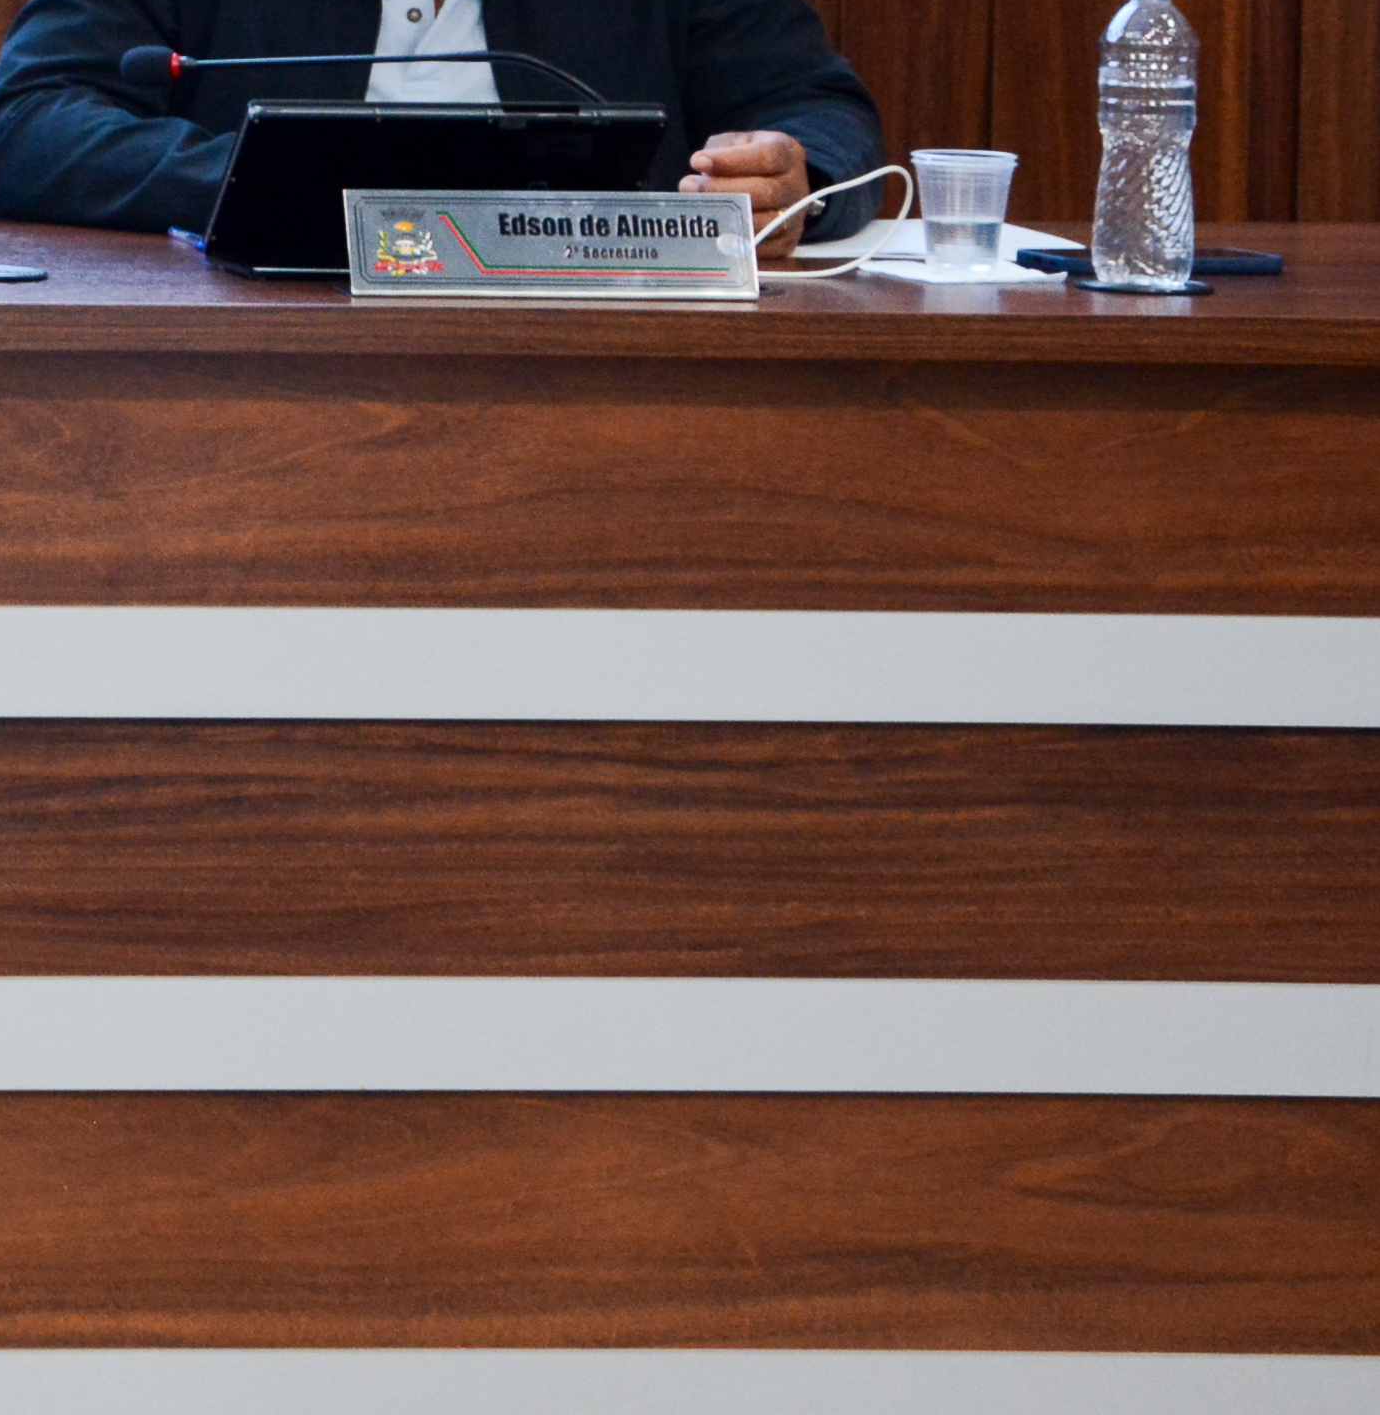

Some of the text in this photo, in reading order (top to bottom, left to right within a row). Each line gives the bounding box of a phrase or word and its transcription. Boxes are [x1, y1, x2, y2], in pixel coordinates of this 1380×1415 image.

[498, 212, 720, 239] Edson de Almeida
[582, 245, 659, 259] Secretário
